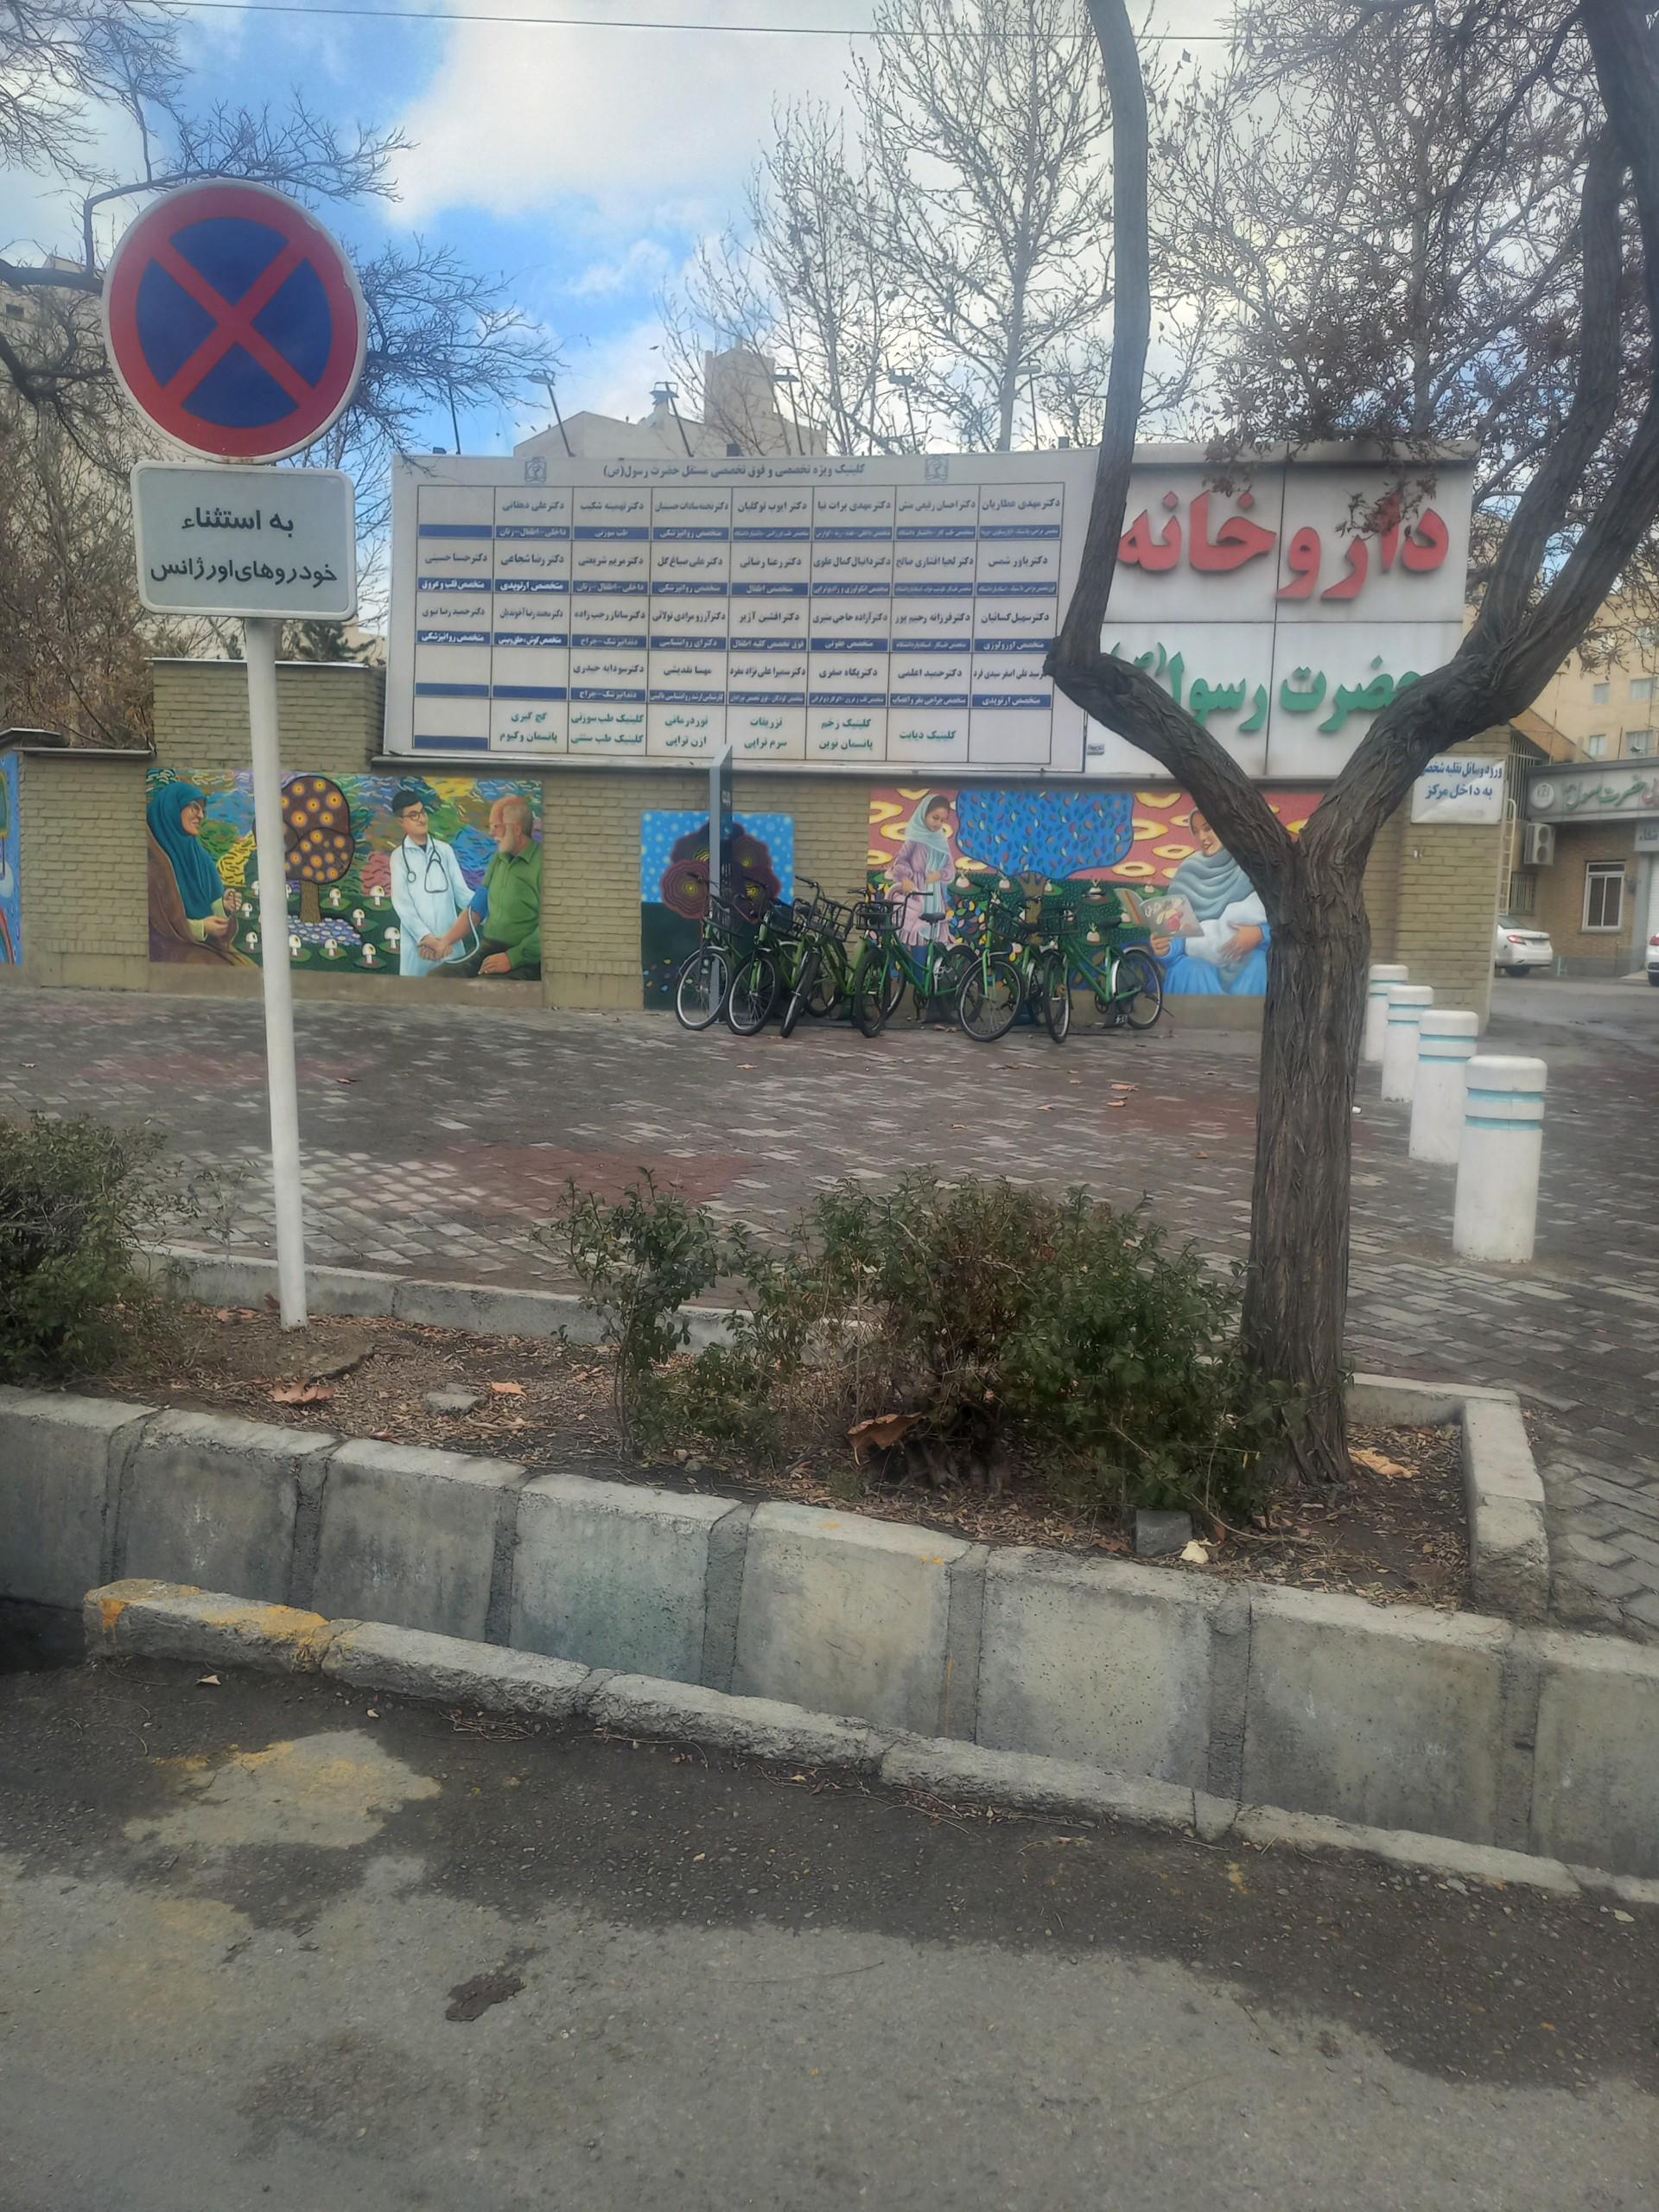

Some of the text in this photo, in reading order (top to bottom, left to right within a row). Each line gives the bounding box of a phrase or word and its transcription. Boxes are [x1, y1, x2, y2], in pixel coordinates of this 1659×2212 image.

[650, 468, 679, 478] حضرت
[531, 501, 547, 512] علی
[547, 501, 564, 512] دکتر
[626, 502, 644, 512] دکتر
[714, 502, 728, 512] دکتر
[789, 501, 807, 512] دکتر
[849, 502, 872, 512] مهدی
[873, 501, 891, 512] دکتر
[958, 499, 976, 511] دکتر
[1018, 501, 1041, 510] مهدی
[1042, 499, 1060, 510] دکتر
[181, 507, 295, 538] به استثناء
[470, 553, 487, 564] دکتر
[500, 554, 564, 566] دکتر رضا شجاعی
[626, 556, 644, 567] دکتر
[689, 557, 704, 568] علی
[705, 557, 722, 568] دکتر
[785, 557, 802, 568] دکتر
[833, 556, 851, 567] کمال
[873, 557, 891, 568] دکتر
[957, 556, 974, 568] دکتر
[1030, 556, 1048, 567] دکتر
[458, 579, 485, 589] متخصص
[531, 581, 563, 591] متخصص
[470, 607, 485, 617] دکتر
[551, 609, 563, 620] دکتر
[628, 611, 645, 621] دکتر
[710, 612, 726, 622] دکتر
[782, 613, 800, 623] دکتر
[871, 613, 888, 624] دکتر
[952, 613, 970, 624] دکتر
[1011, 613, 1049, 624] دکتر سهیل
[422, 632, 484, 643] متخصص روانپزشکی
[1017, 641, 1044, 650] متخصص
[627, 664, 644, 675] دکتر
[791, 667, 805, 677] دکتر
[861, 668, 878, 678] دکتر
[945, 669, 962, 679] دکتر
[925, 671, 945, 680] حمید
[842, 719, 872, 728] کلینیک
[526, 732, 558, 743] پانسمان
[614, 734, 643, 743] کلینیک
[841, 739, 873, 750] پانسمان
[1484, 766, 1503, 779] ورود
[1425, 784, 1492, 800] به داخل مرکز
